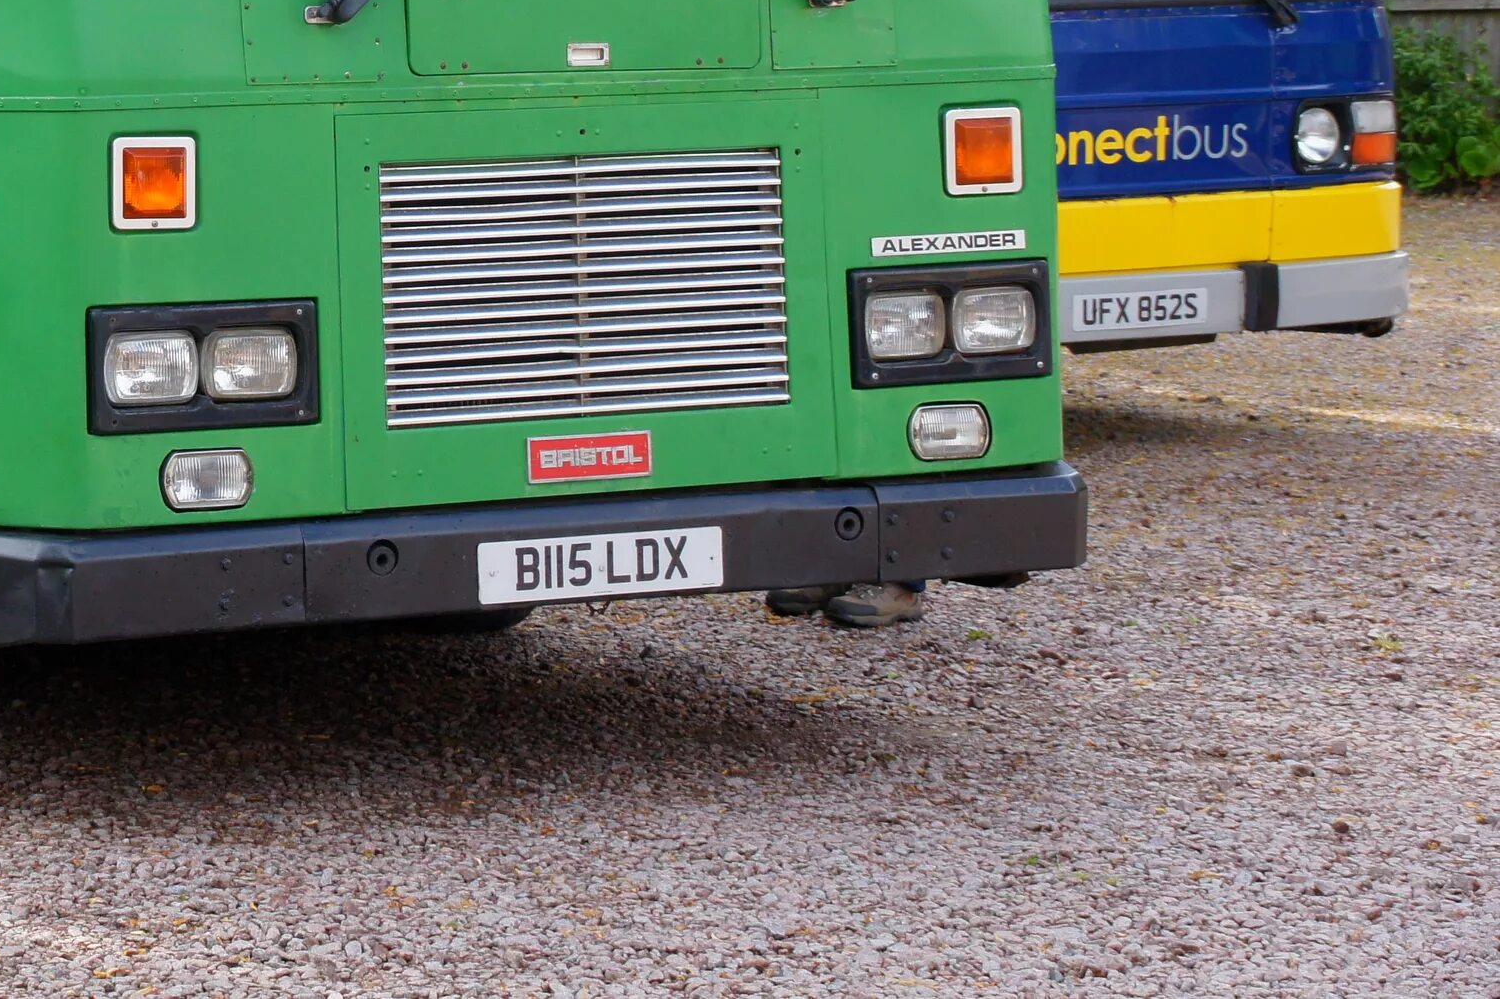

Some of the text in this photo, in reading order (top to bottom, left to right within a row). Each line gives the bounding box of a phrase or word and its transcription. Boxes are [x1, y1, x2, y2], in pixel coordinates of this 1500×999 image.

[881, 233, 1016, 253] ALEXANDER
[1083, 293, 1198, 325] UFX 852S
[540, 444, 643, 469] BRISTOL
[515, 535, 688, 591] B115 LDX
